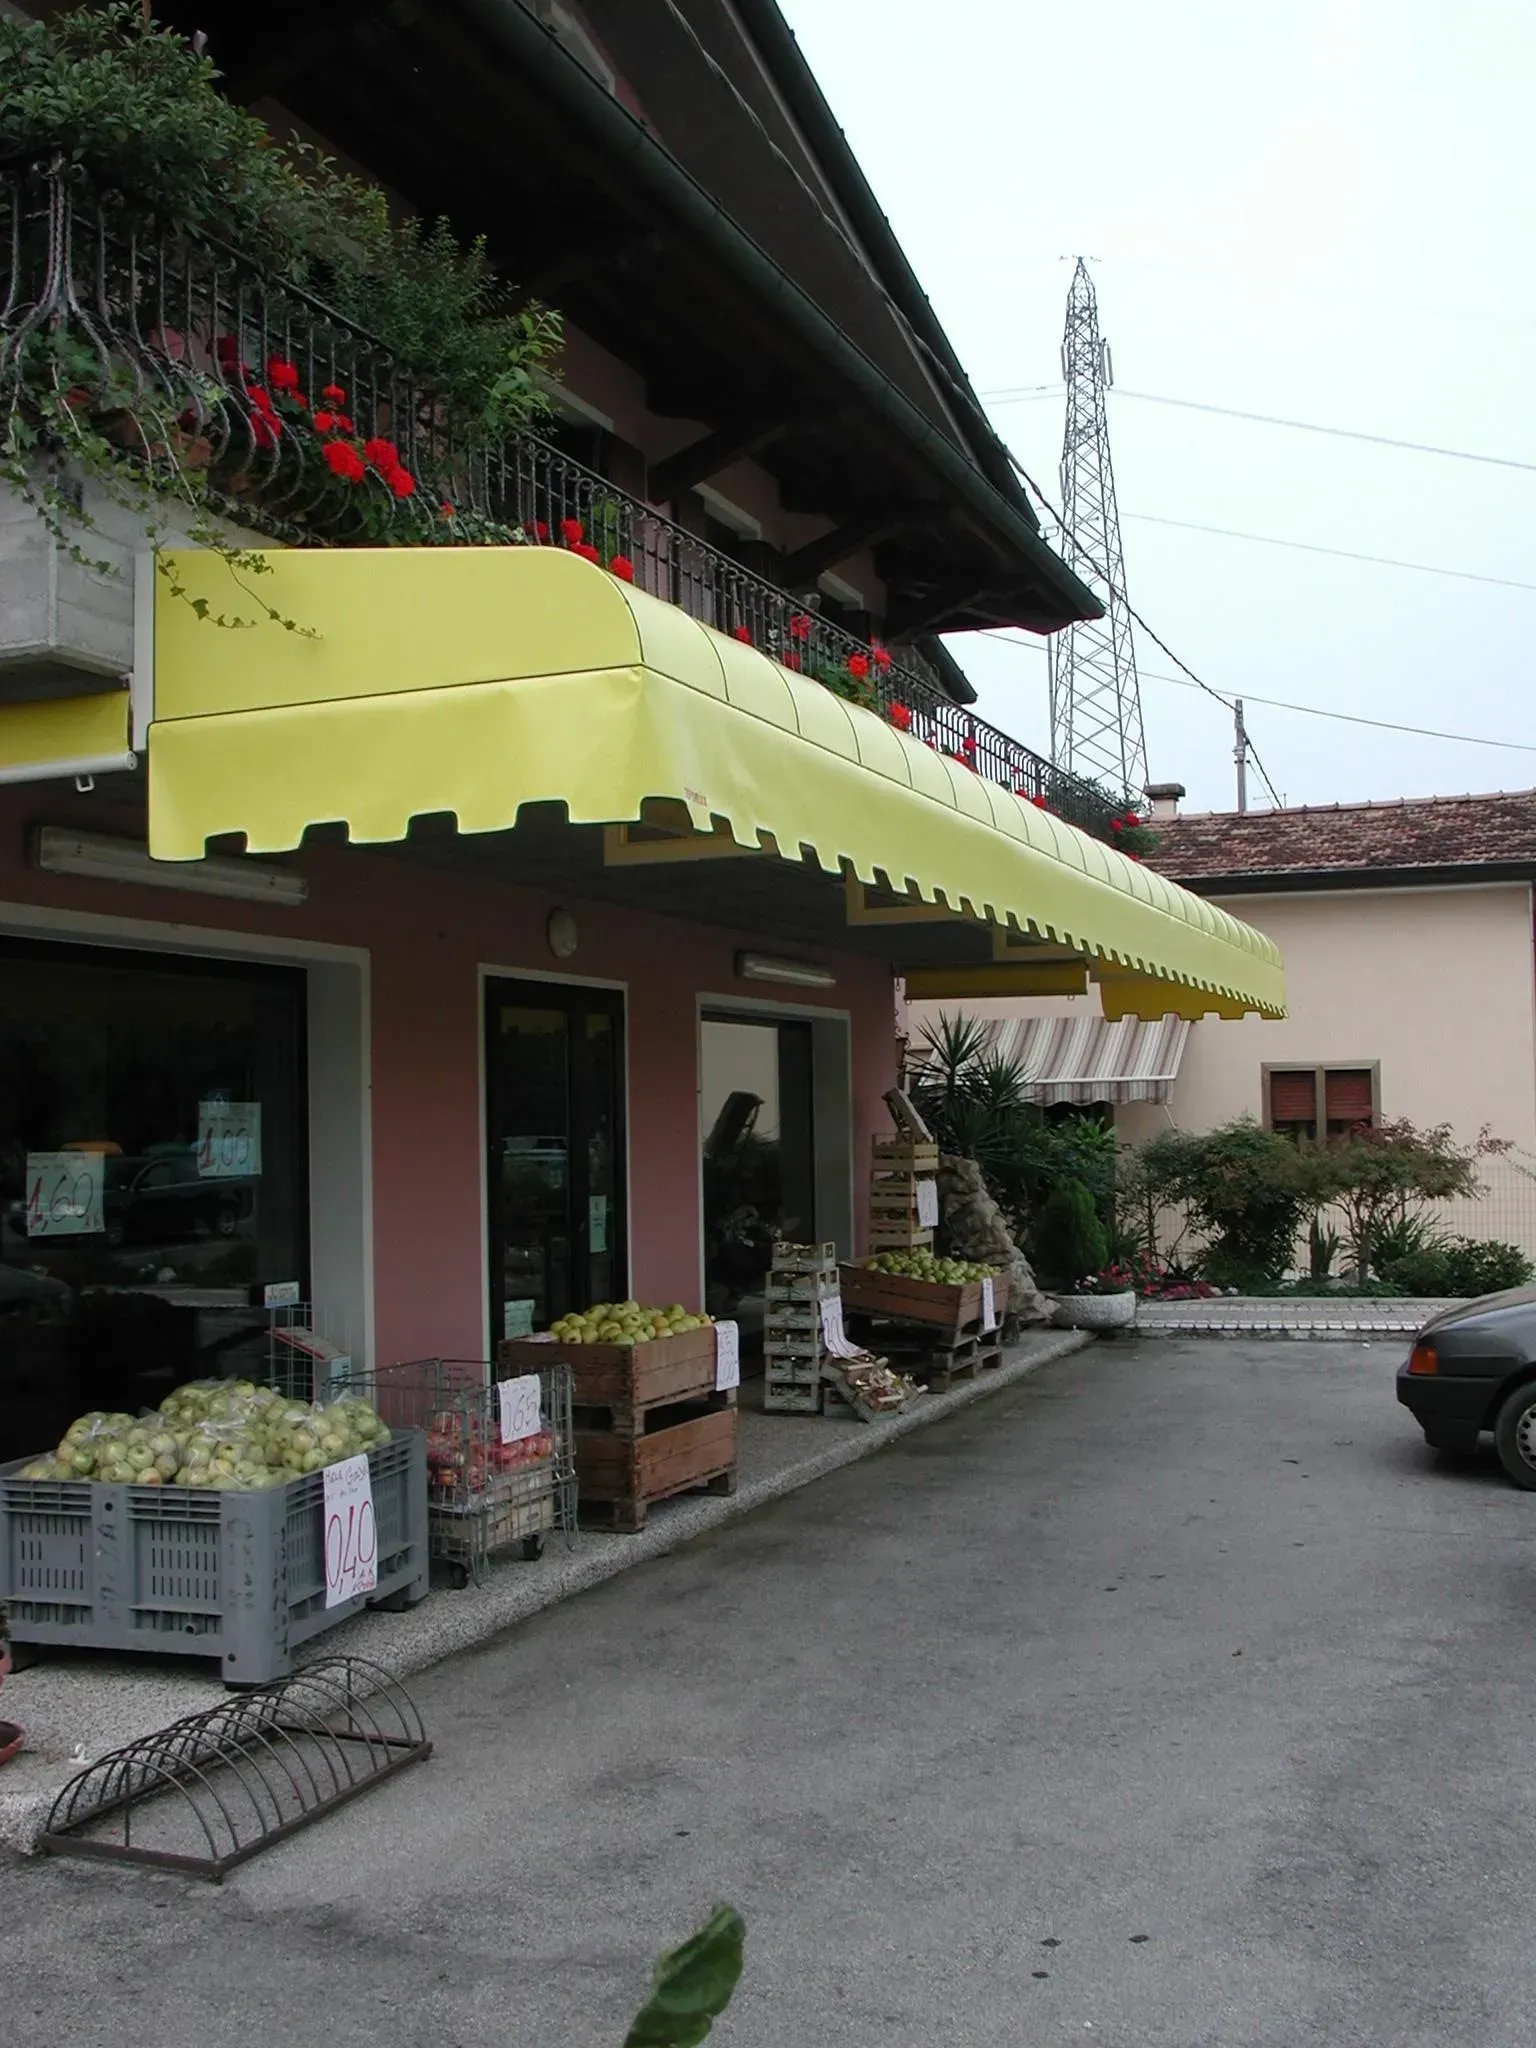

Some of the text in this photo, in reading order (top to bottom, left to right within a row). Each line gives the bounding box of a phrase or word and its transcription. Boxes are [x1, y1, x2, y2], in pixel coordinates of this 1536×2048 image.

[199, 1127, 250, 1173] 1,00
[27, 1172, 94, 1232] 1,60
[326, 1501, 376, 1595] 0,40
